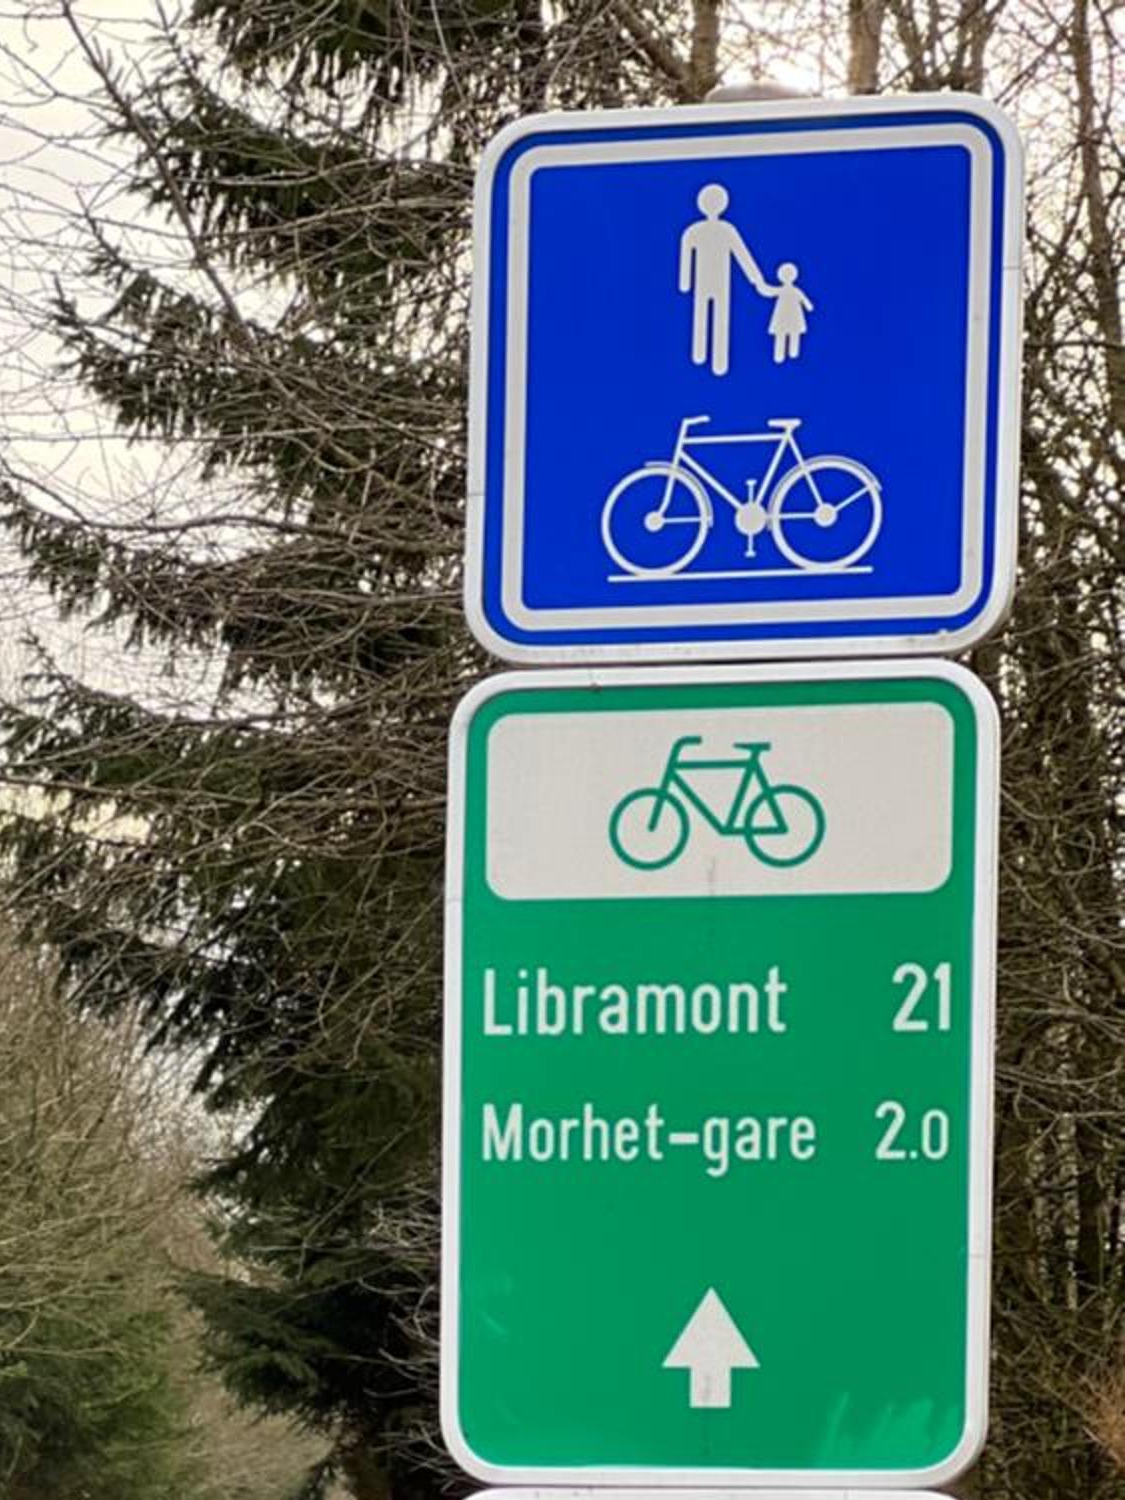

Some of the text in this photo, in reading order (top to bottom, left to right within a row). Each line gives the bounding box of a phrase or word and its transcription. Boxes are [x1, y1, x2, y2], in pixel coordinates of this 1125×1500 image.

[483, 962, 952, 1035] Libramont 21
[482, 1101, 950, 1177] Morhet-gare 2.0
